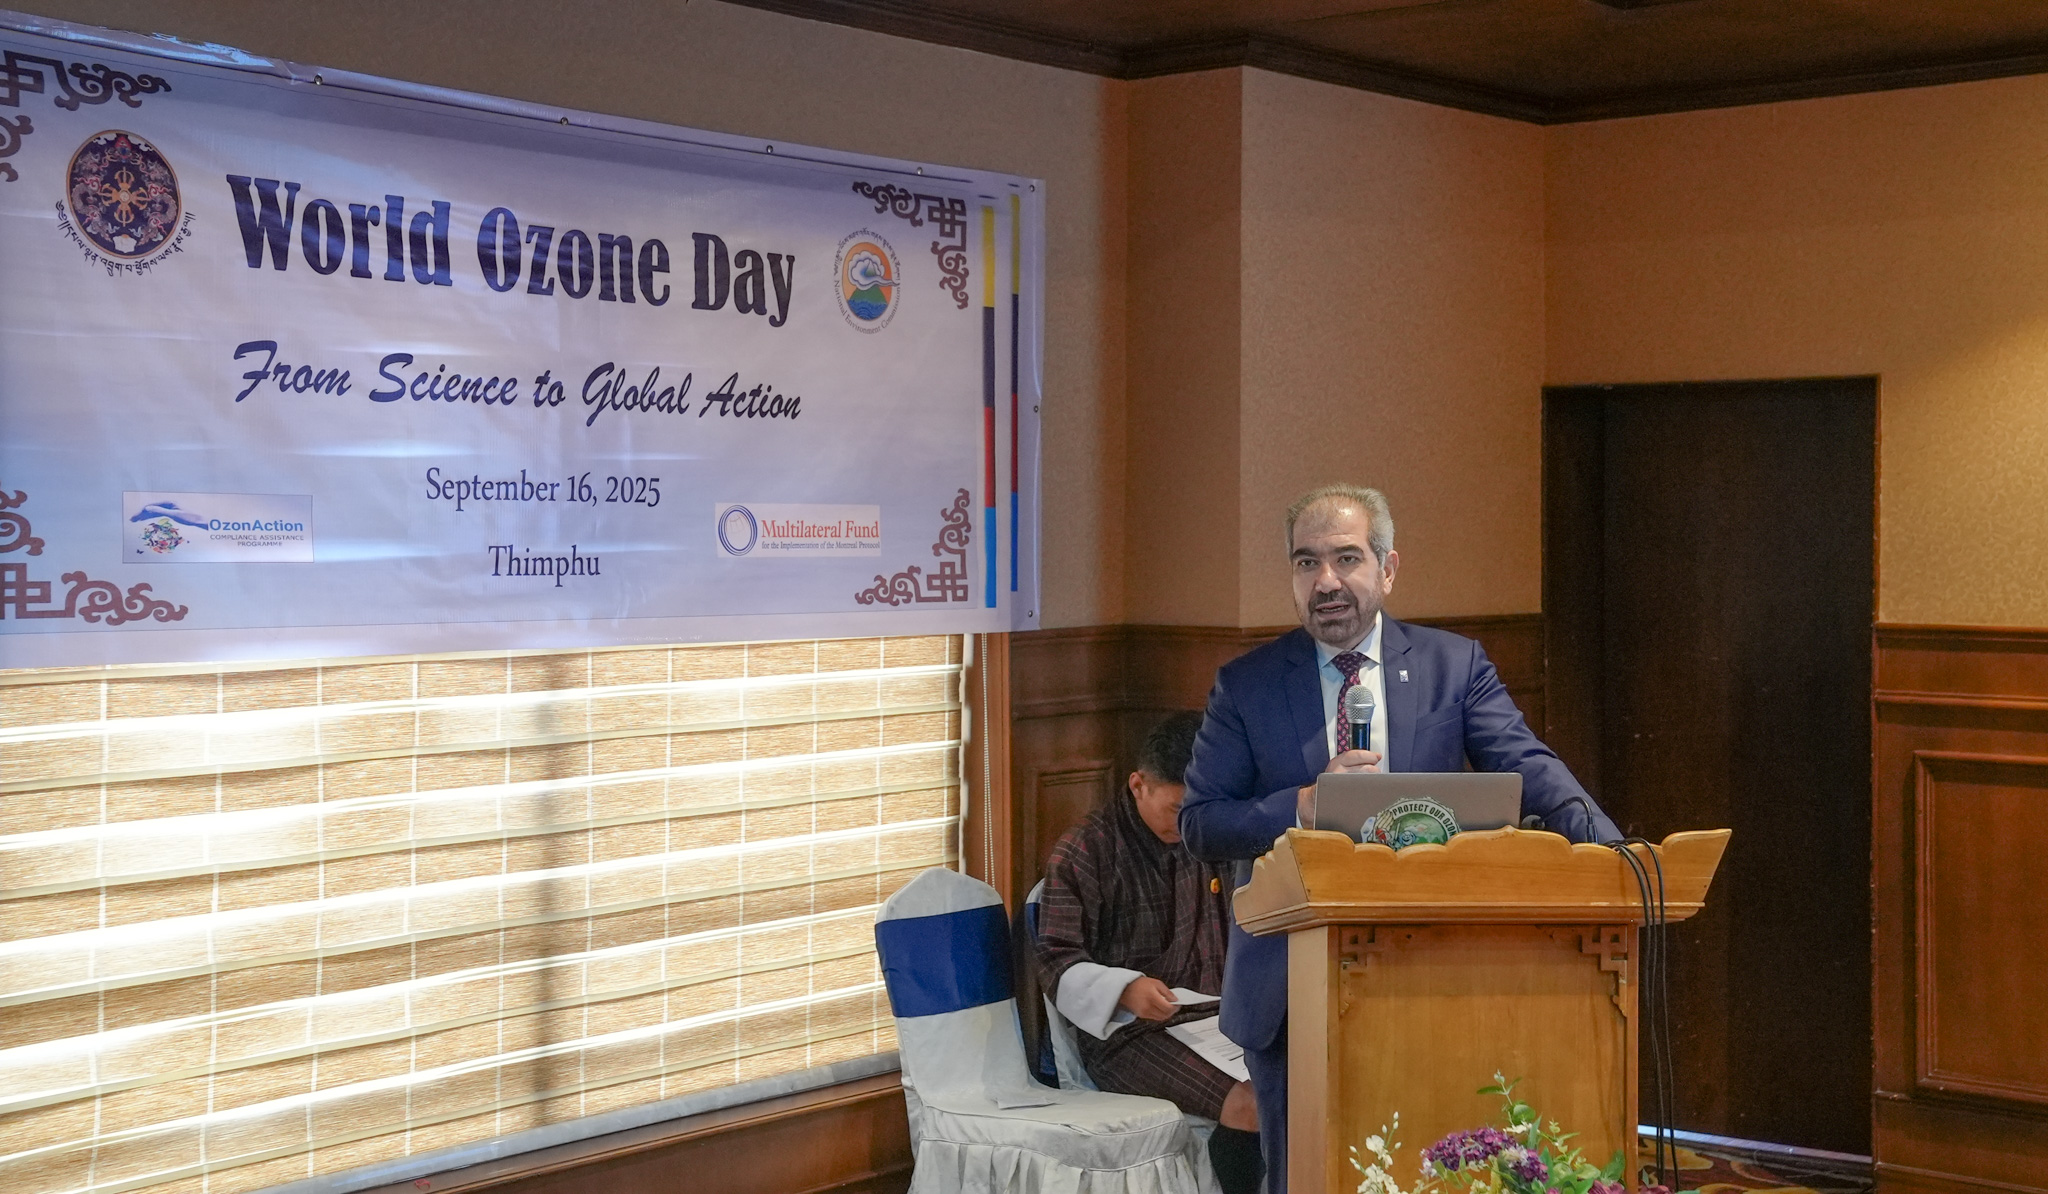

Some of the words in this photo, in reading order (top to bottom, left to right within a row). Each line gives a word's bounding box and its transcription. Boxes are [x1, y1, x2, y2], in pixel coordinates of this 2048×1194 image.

[226, 173, 453, 287] World
[477, 206, 671, 306] Ozone
[691, 231, 795, 328] Day
[834, 280, 847, 316] National
[845, 315, 882, 334] Environment
[881, 287, 900, 329] Commission
[233, 340, 352, 403] From
[369, 352, 519, 403] Science
[532, 369, 566, 409] to
[582, 361, 690, 427] Global
[698, 372, 802, 421] Action
[426, 467, 560, 512] September
[566, 472, 598, 507] 16,
[605, 476, 661, 508] 2025
[209, 519, 303, 532] OzonAction
[761, 520, 841, 538] Multilateral
[845, 521, 879, 538] Fund
[761, 541, 770, 550] for
[771, 541, 780, 550] the
[780, 541, 820, 551] Implementation
[820, 541, 827, 549] of
[827, 541, 835, 550] the
[835, 541, 858, 550] Montreal
[858, 541, 881, 550] Protocol
[488, 544, 601, 587] Thimphu
[1393, 804, 1429, 816] PROTECT
[1429, 807, 1444, 820] OUR
